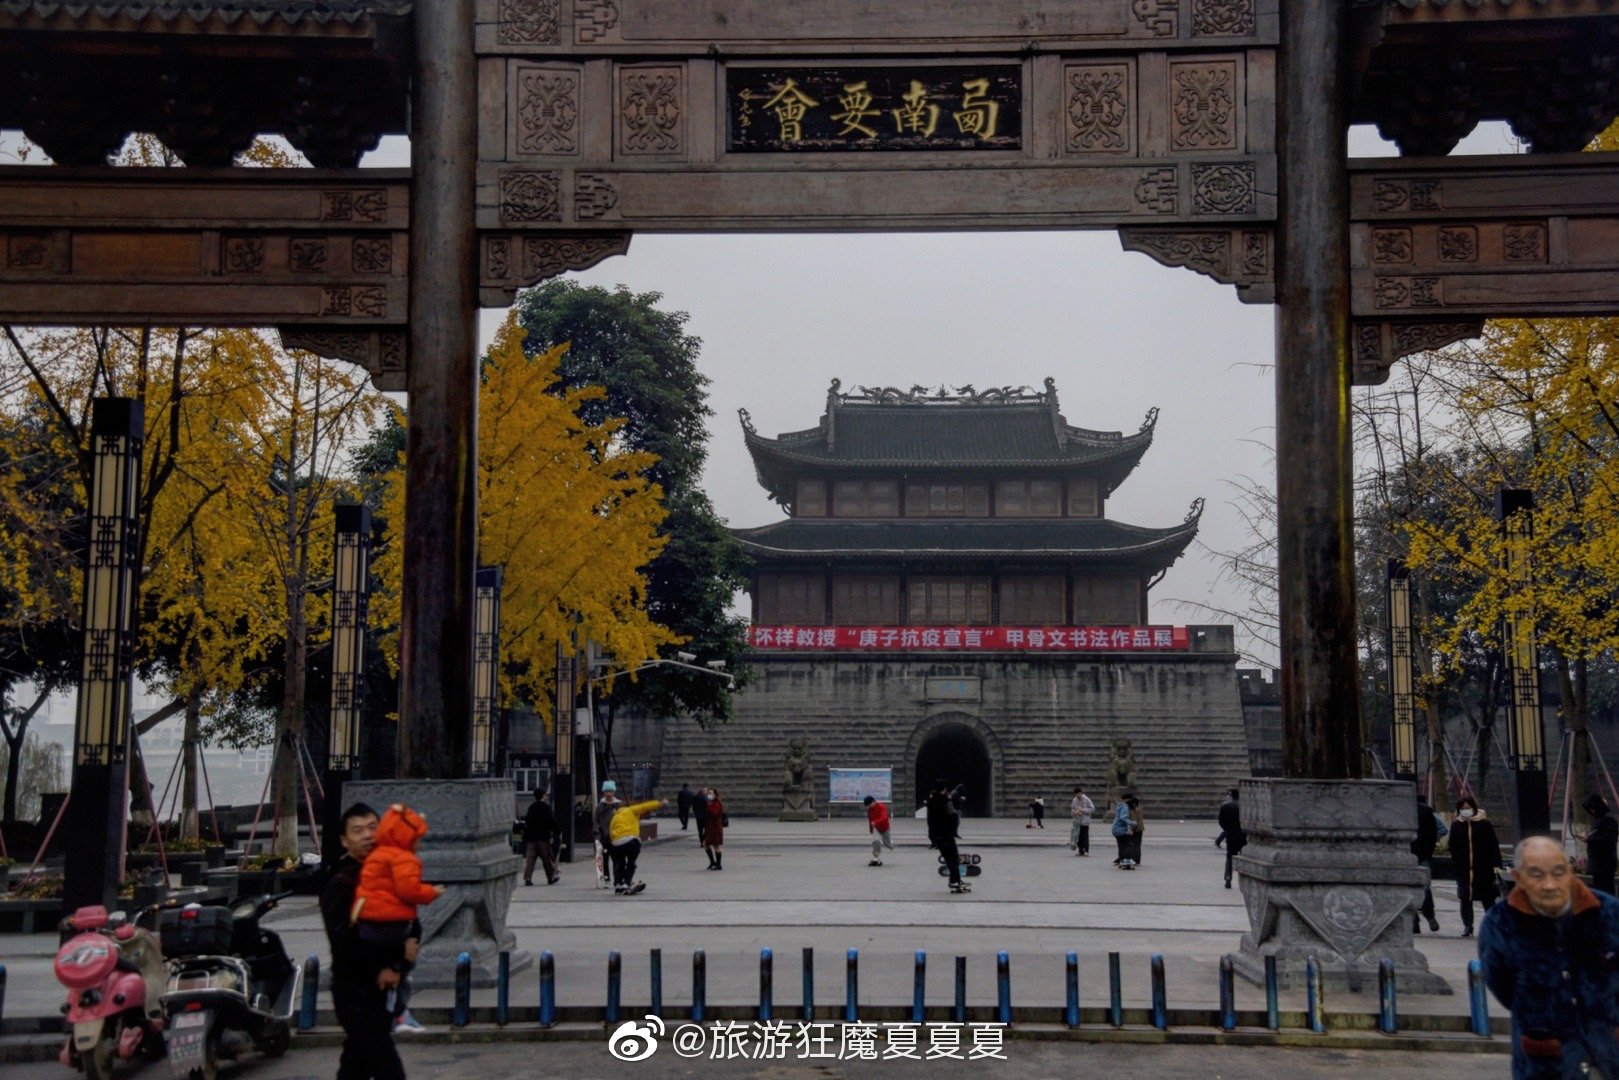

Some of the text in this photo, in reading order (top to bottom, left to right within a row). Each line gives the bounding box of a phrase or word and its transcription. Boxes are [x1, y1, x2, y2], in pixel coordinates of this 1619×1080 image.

[1006, 630, 1173, 647] 甲骨文书法作品展
